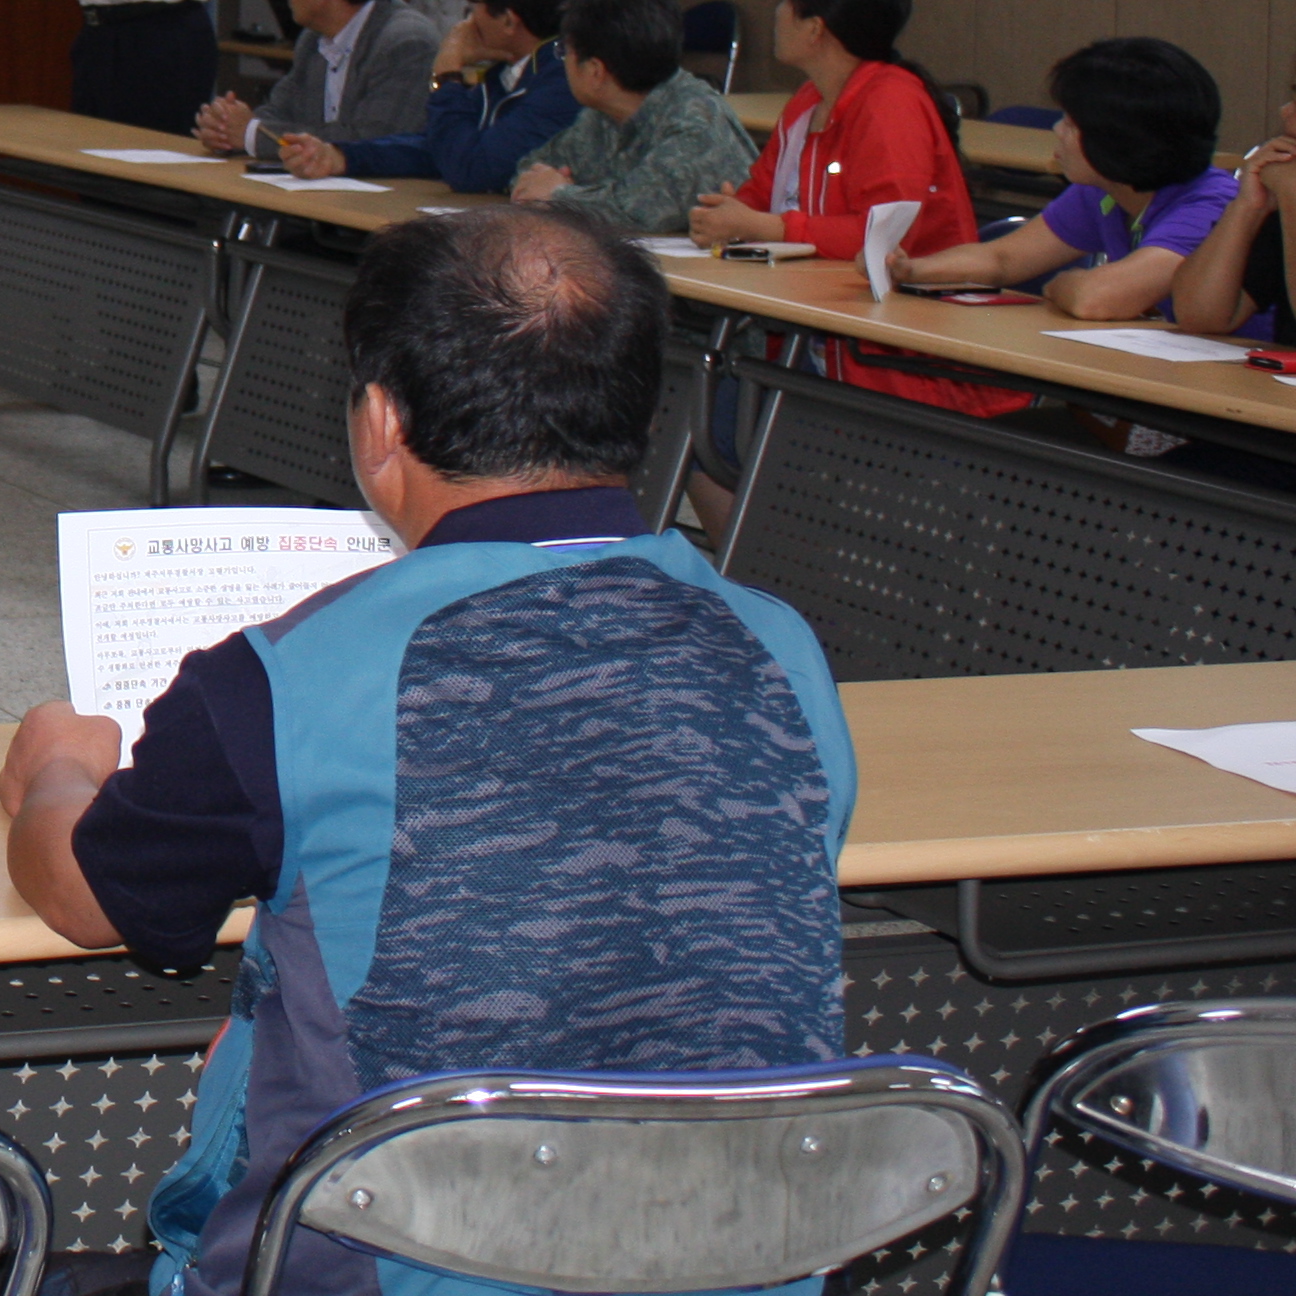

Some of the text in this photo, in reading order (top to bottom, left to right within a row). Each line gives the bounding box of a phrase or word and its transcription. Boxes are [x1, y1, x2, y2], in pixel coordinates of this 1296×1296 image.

[146, 536, 233, 555] 교통사망사고
[240, 536, 270, 552] 예방
[278, 535, 338, 552] 집중단속
